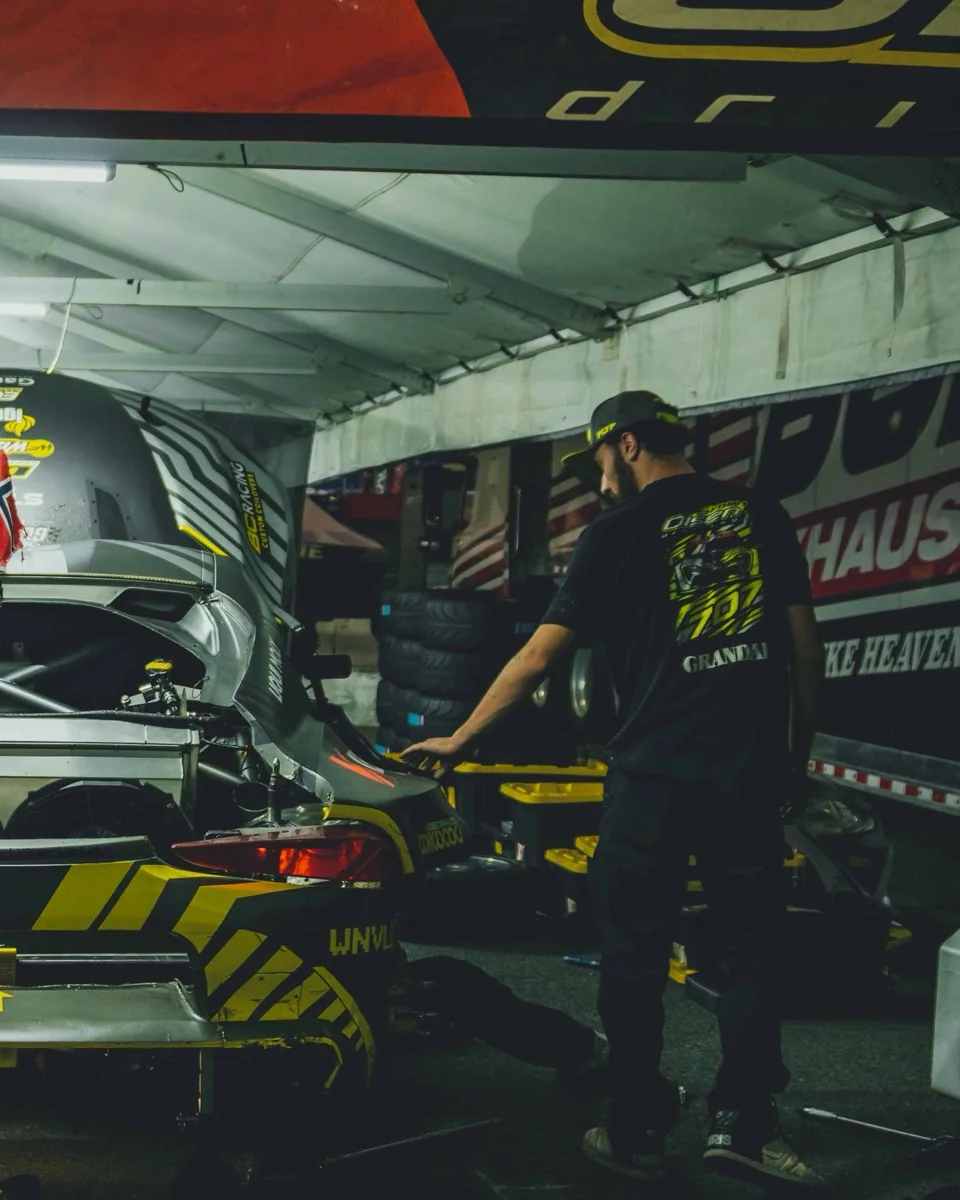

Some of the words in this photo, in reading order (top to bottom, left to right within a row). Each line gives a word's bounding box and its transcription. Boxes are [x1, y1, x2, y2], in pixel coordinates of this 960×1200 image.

[230, 461, 254, 515] RACING
[247, 473, 263, 514] COILOVERS
[243, 512, 262, 554] BC
[257, 515, 269, 549] CUSTOM
[796, 481, 960, 583] HAUS
[823, 638, 861, 679] KE
